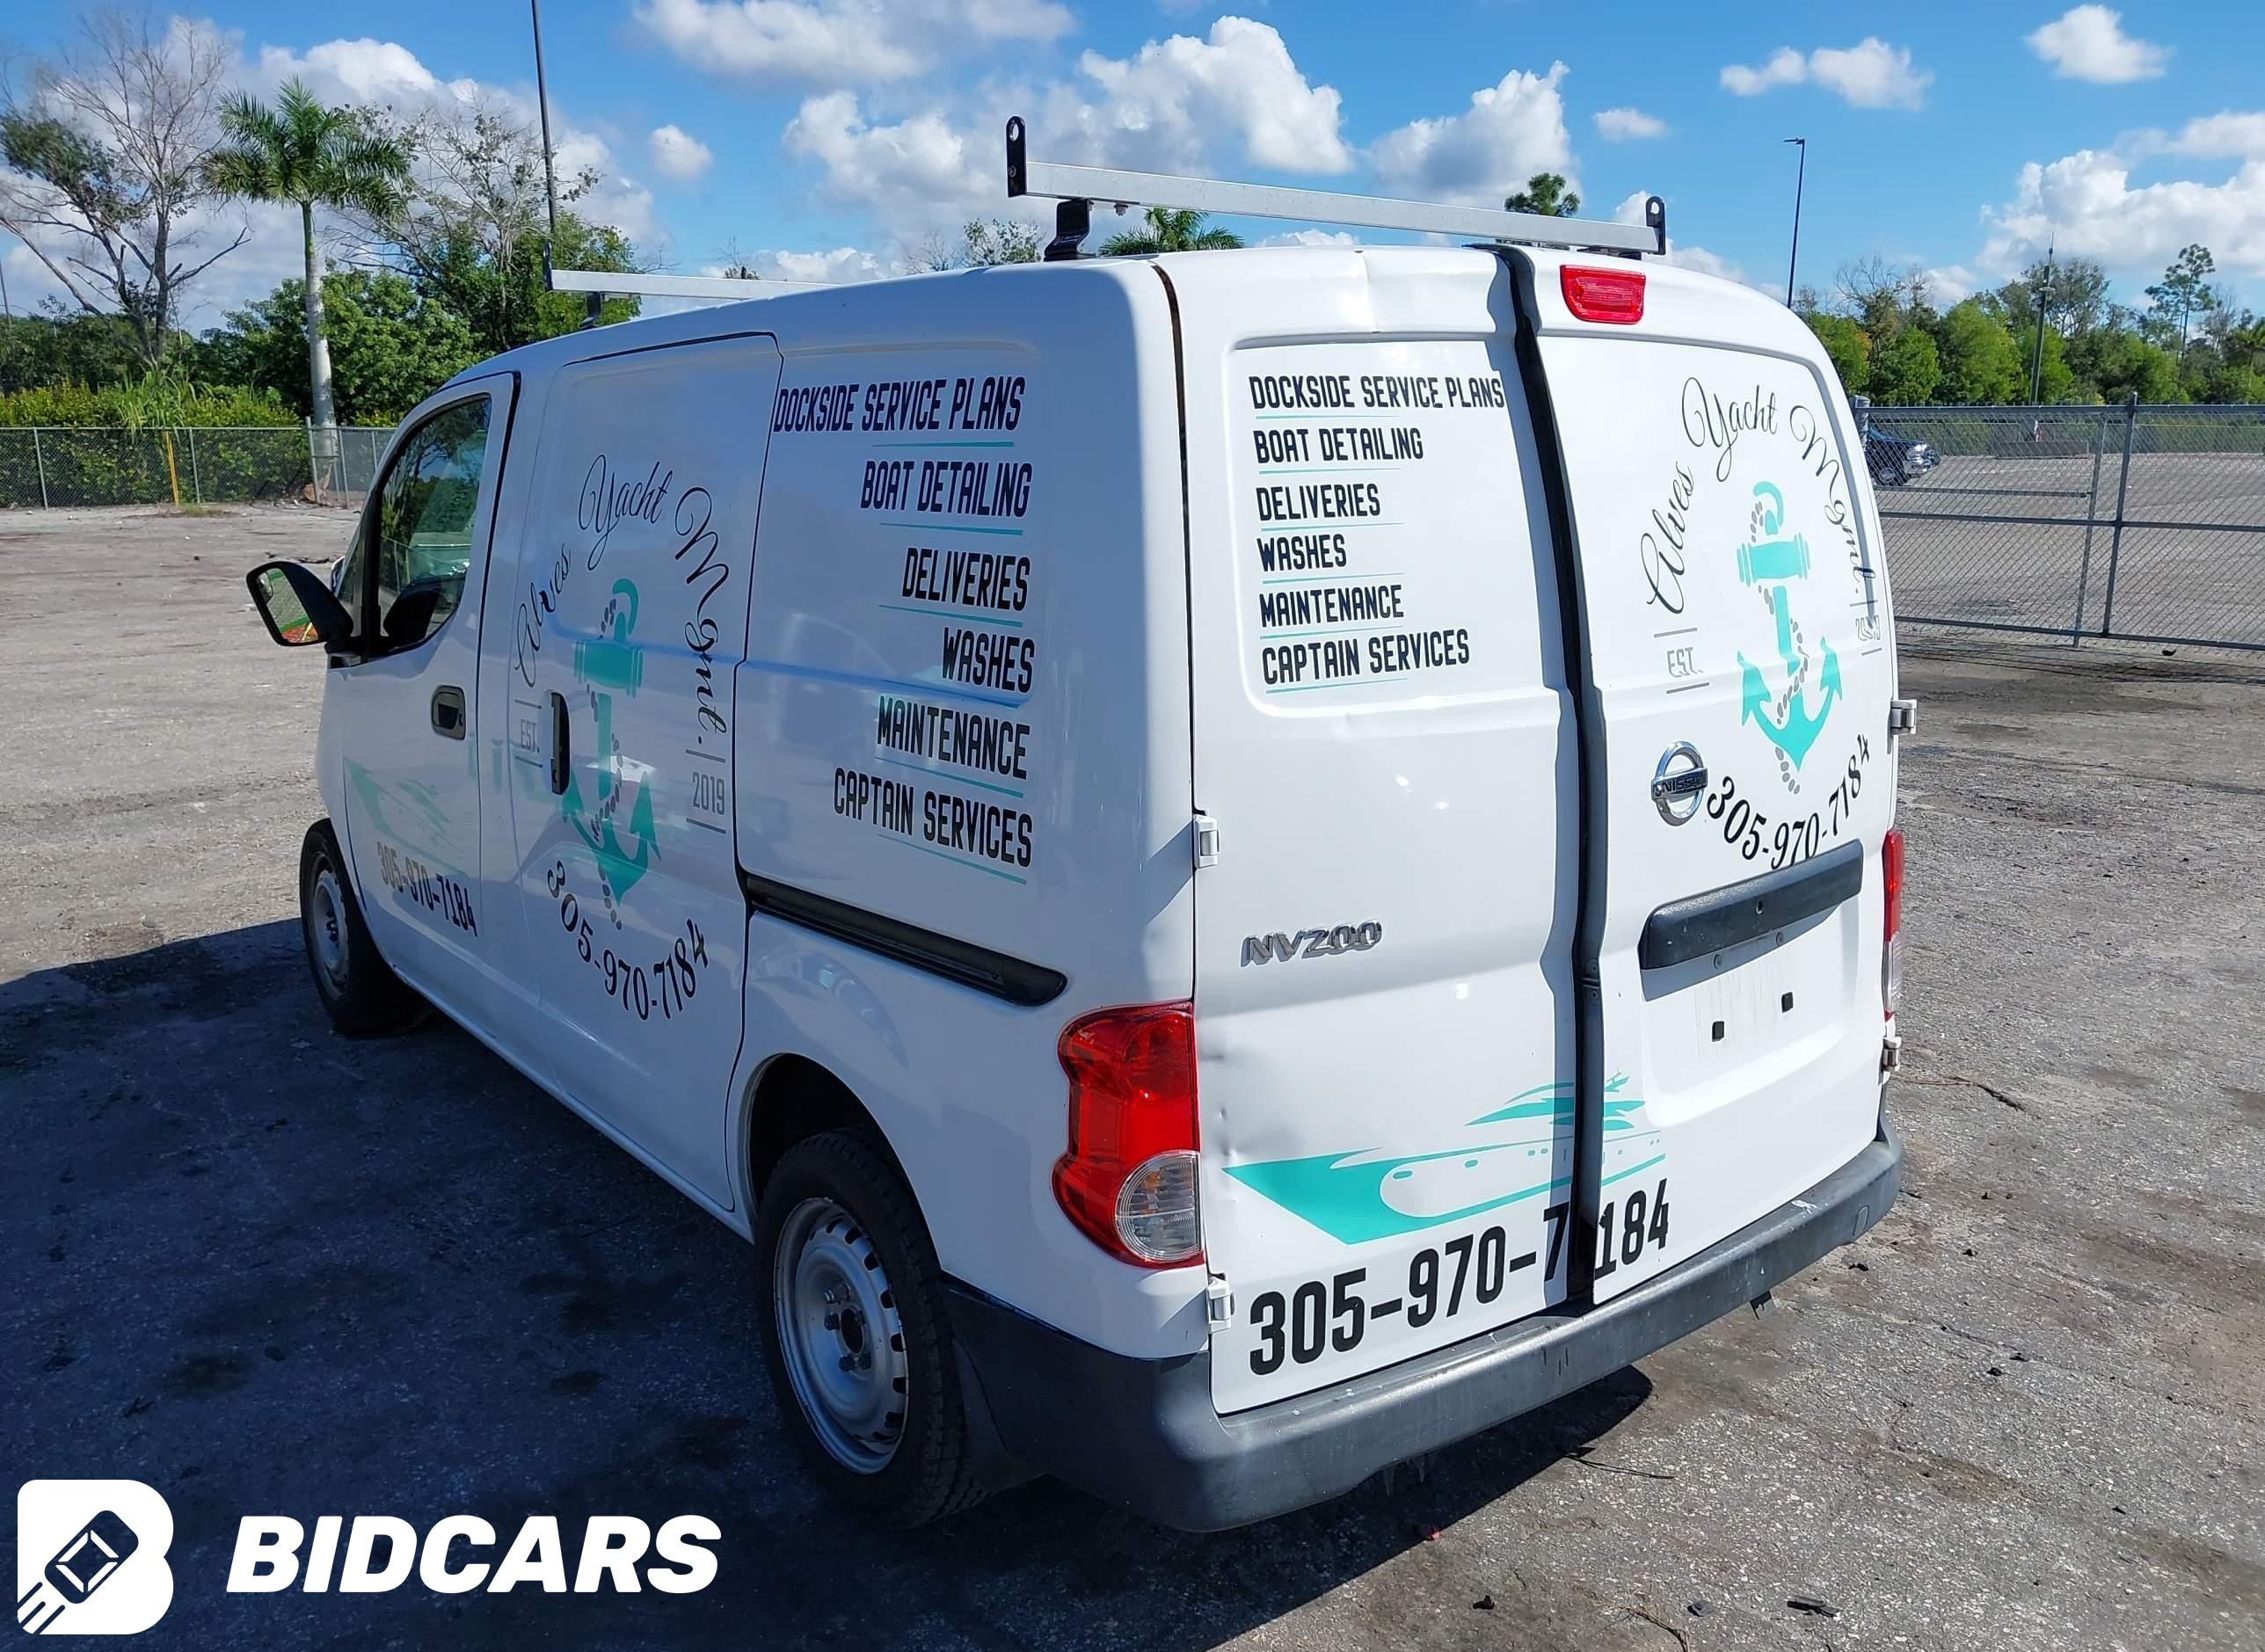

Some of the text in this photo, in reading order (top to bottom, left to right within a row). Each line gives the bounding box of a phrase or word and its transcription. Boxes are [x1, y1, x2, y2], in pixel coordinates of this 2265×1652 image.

[774, 375, 1026, 433] DOCKSIDE SERVICE PLANS
[1248, 375, 1505, 410] DOCKSIDE SERVICE PLANS
[1253, 426, 1424, 464] BOAT DETAILING
[860, 460, 1033, 518] BOAT DETAILING
[1256, 483, 1381, 522] DELIVERIES
[1641, 460, 1694, 615] Alves
[1681, 376, 1779, 482] Yacht
[514, 542, 572, 688] Alves
[577, 454, 673, 571] Yacht
[901, 547, 1031, 612] DELIVERIES
[1256, 533, 1347, 572] WASHES
[1258, 584, 1405, 629] MAINTENANCE
[941, 626, 1035, 695] WASHES
[1262, 628, 1470, 686] CAPTAIN SERVICES
[1666, 646, 1706, 679] EST.
[521, 718, 540, 753] EST.
[877, 695, 1031, 781] MAINTENANCE
[692, 771, 725, 816] 2019
[833, 766, 1033, 868] CAPTAIN SERVICES
[1707, 733, 1870, 870] 305-970-7184
[376, 841, 478, 938] 305-970-7184
[546, 859, 708, 1022] 305-970-7184
[1241, 920, 1383, 968] NV200
